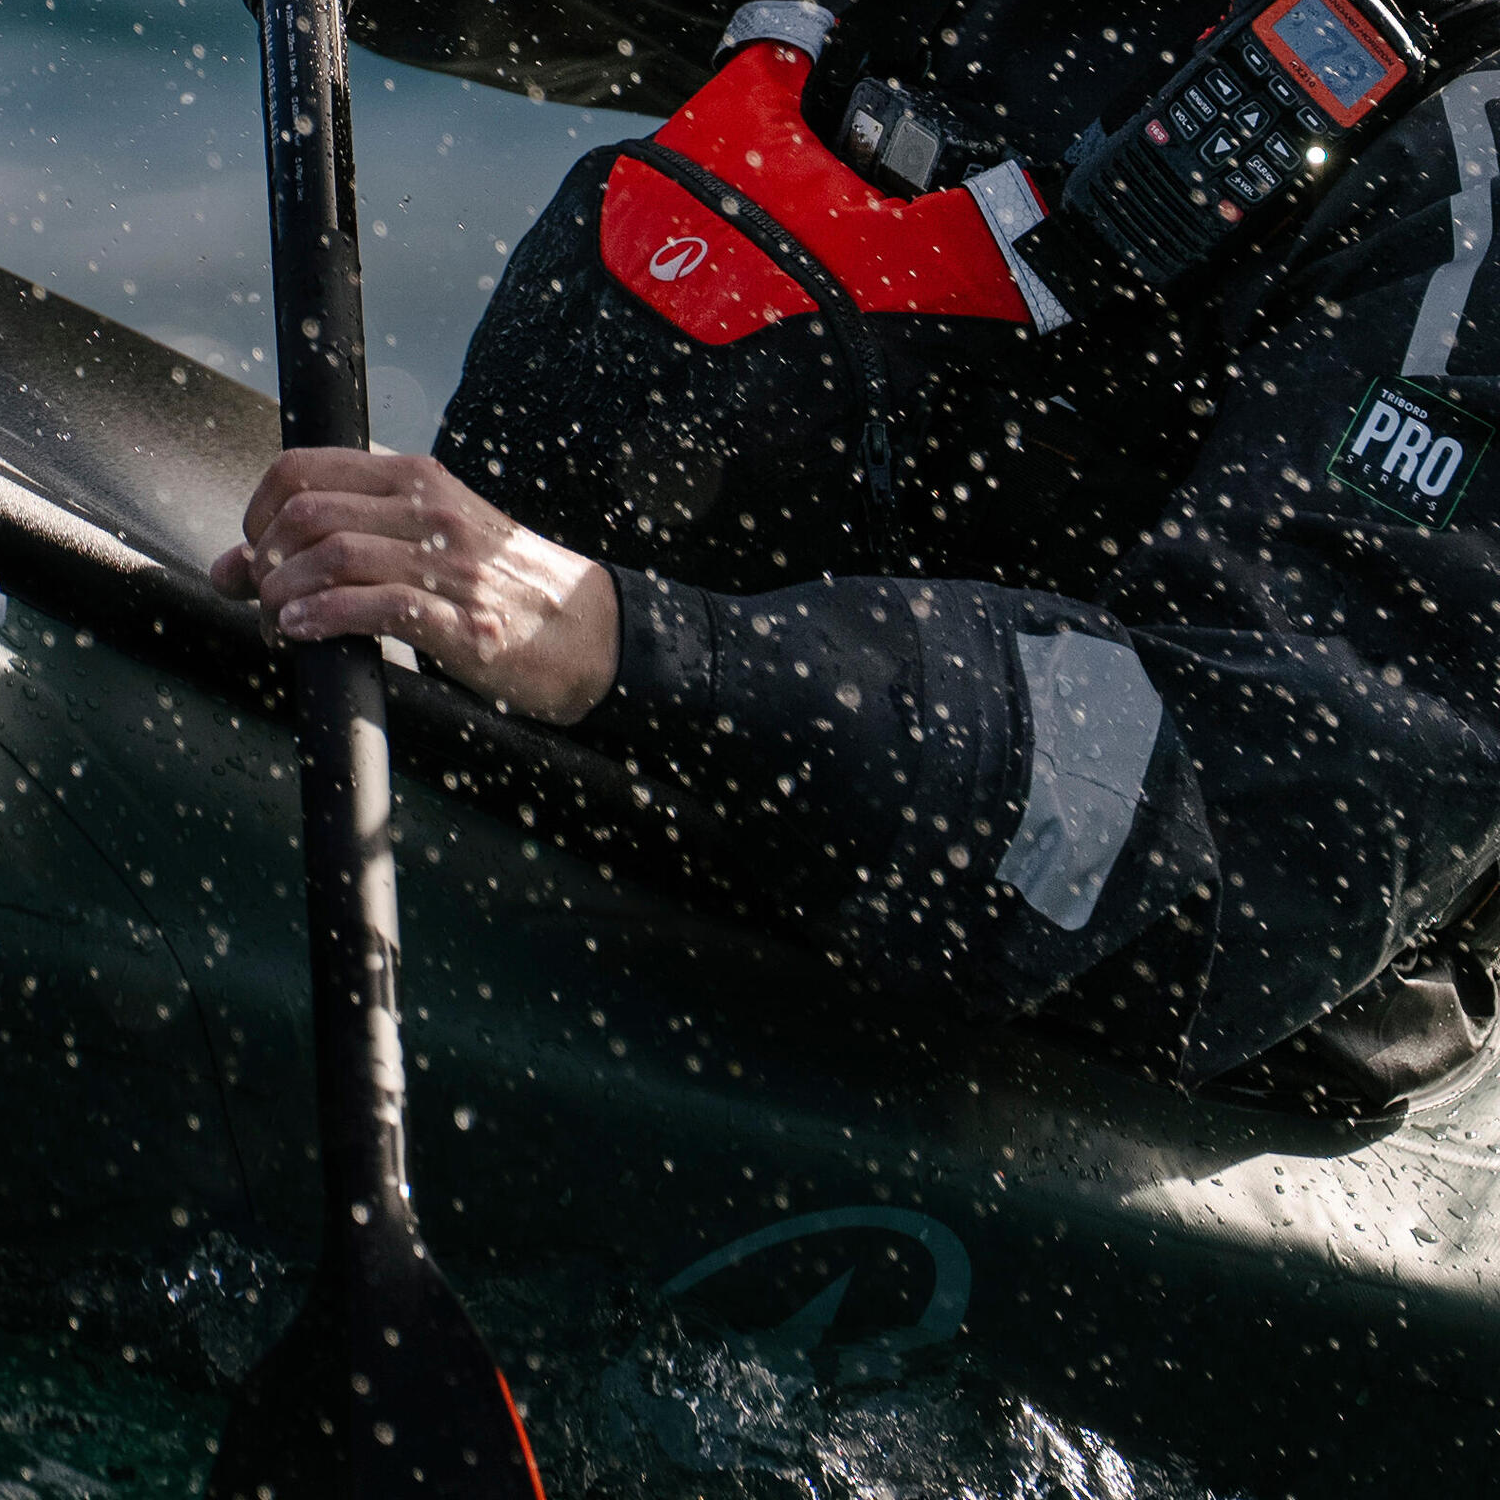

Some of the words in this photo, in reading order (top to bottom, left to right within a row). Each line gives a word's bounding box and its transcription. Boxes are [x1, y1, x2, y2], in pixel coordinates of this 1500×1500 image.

[1359, 28, 1395, 67] HORIZON
[1381, 388, 1428, 420] TRIBORD
[1351, 400, 1463, 497] PRO
[1346, 454, 1438, 511] SERIES
